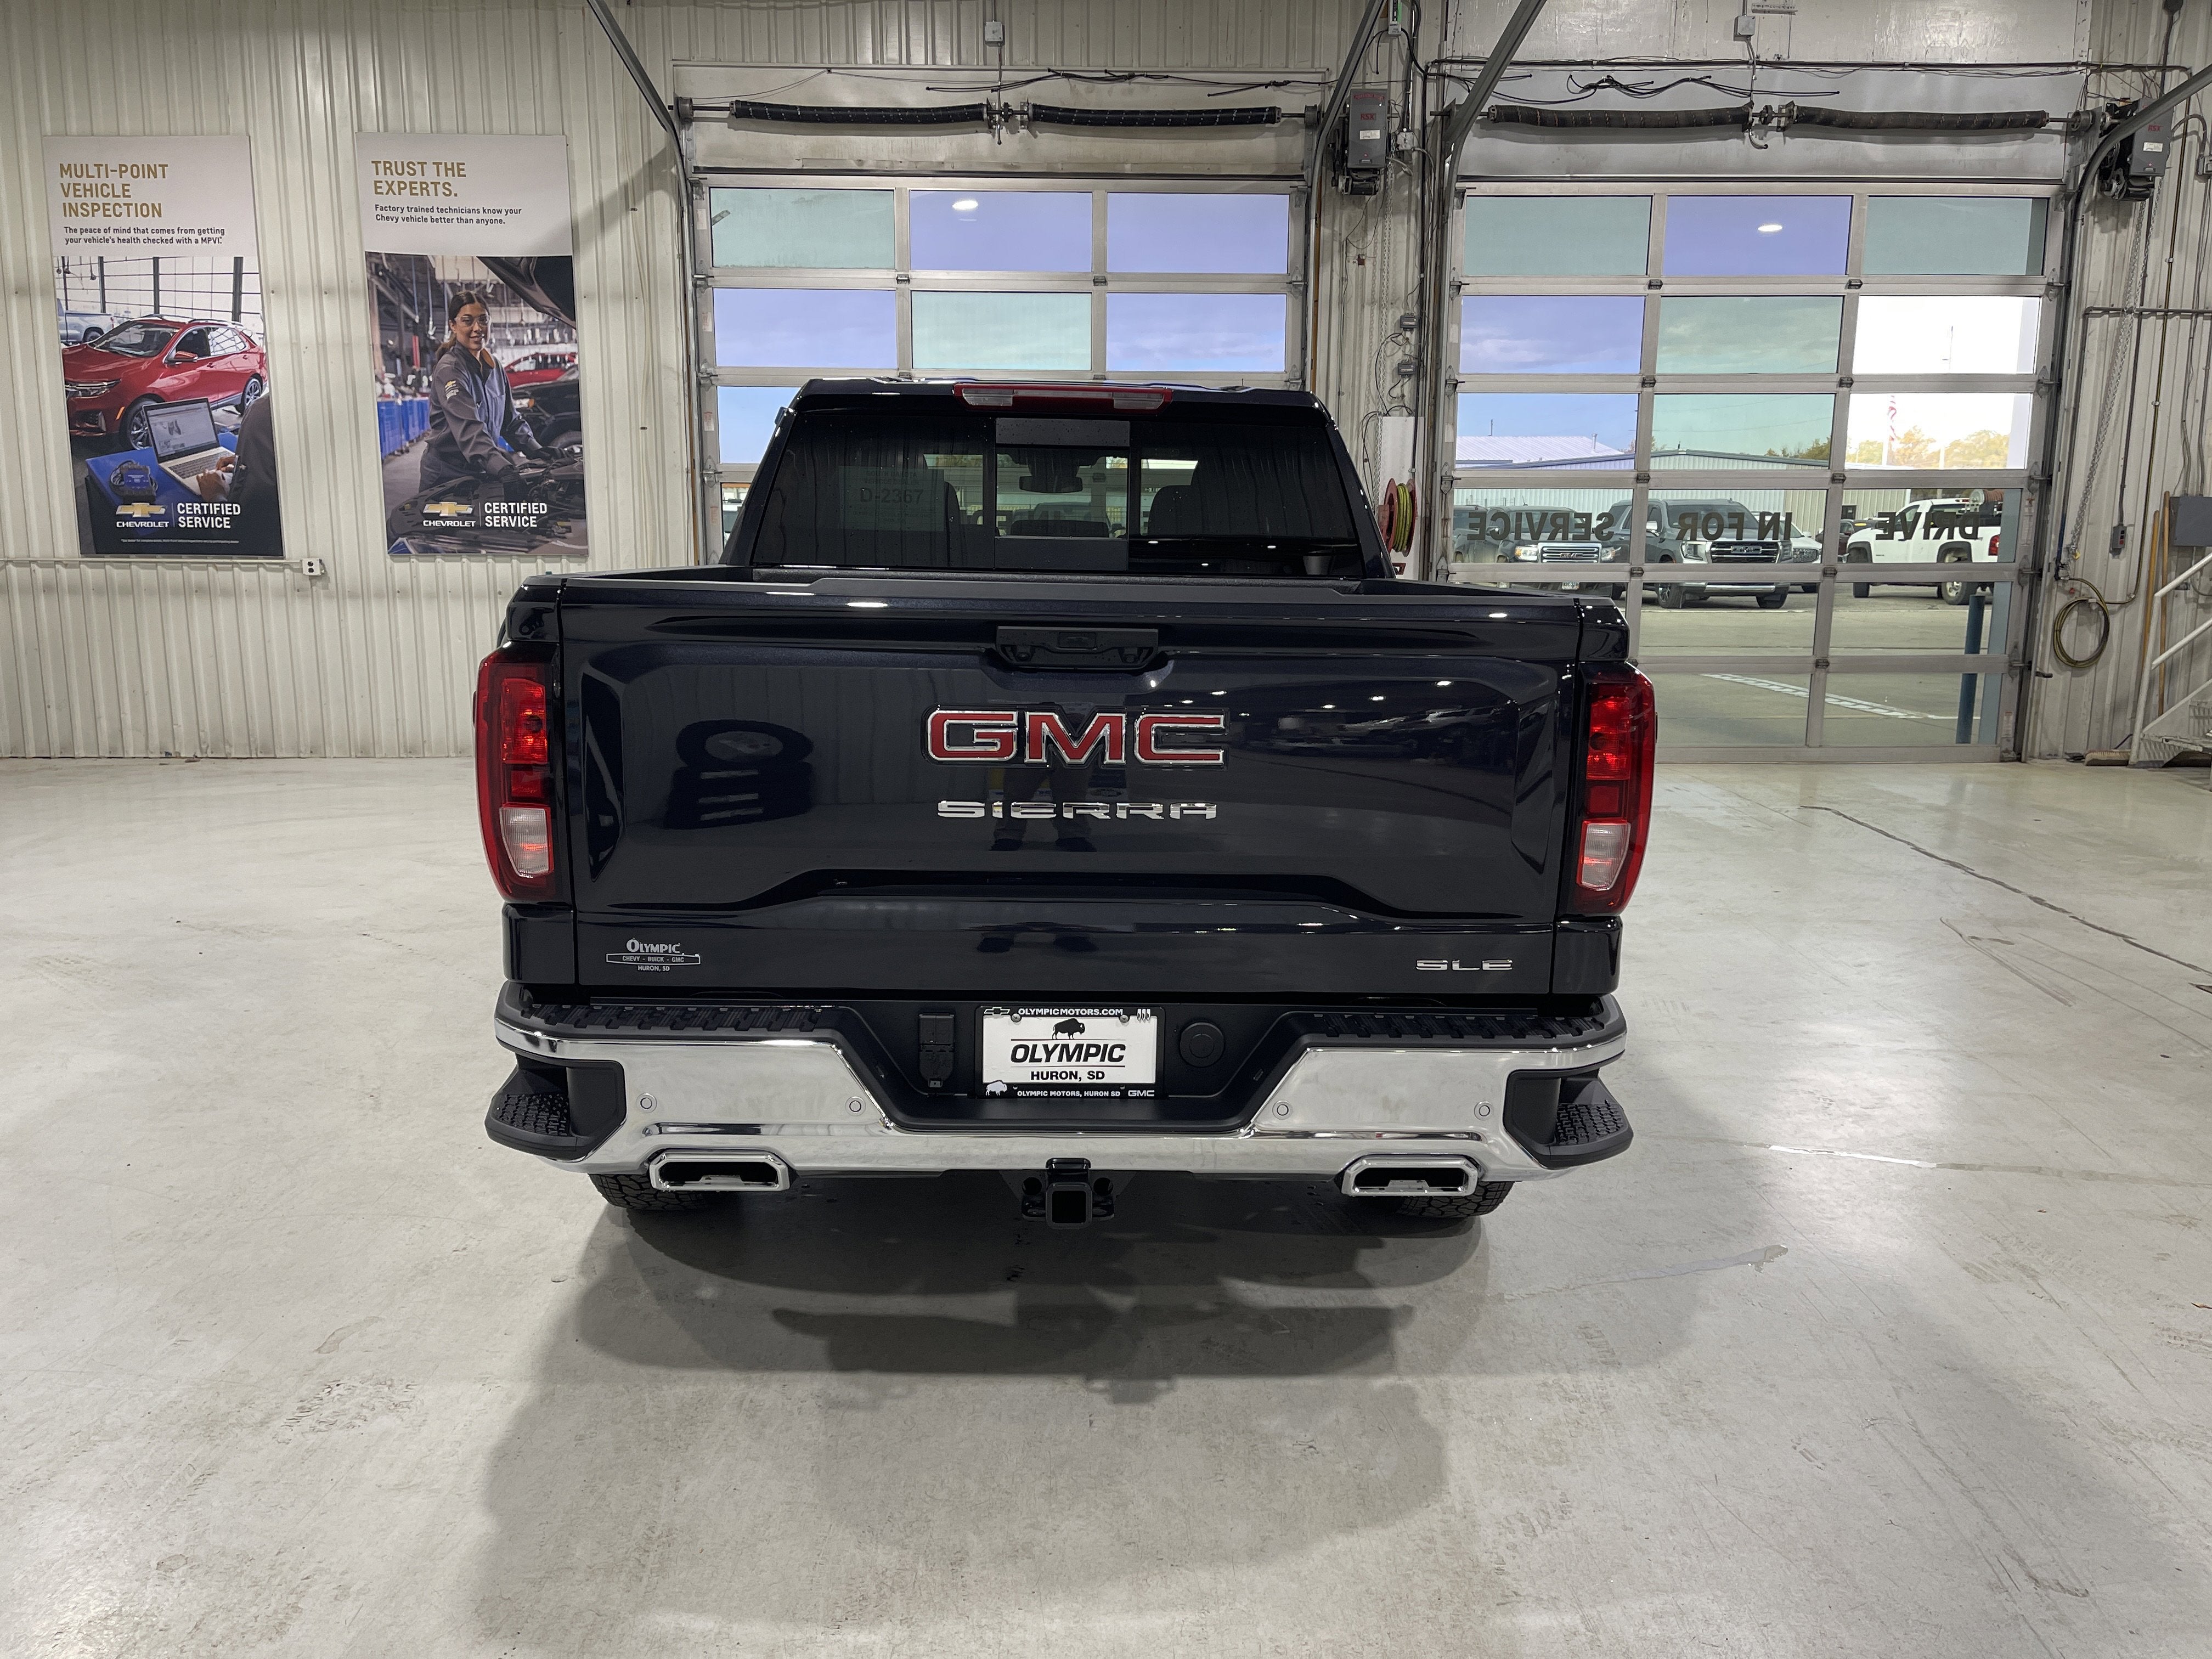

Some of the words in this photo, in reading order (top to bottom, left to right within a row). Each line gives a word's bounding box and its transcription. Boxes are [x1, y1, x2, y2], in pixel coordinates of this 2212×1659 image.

[60, 163, 168, 179] MULTI-POINT
[371, 161, 427, 176] TRUST
[432, 162, 466, 177] THE
[60, 183, 131, 198] VEHICLE
[374, 180, 458, 197] EXPERTS.
[63, 202, 162, 218] INSPECTION
[375, 204, 405, 213] Factory
[437, 206, 480, 214] technicians
[376, 215, 399, 223] Chevy
[198, 227, 225, 236] getting
[860, 487, 924, 504] D-2367
[177, 503, 241, 515] CERTIFIED
[484, 502, 547, 515] CERTIFIED
[178, 516, 231, 529] SERVICE
[485, 516, 537, 527] SERVICE
[927, 710, 1224, 766] GMC
[938, 800, 1217, 820] SIERRA
[1416, 959, 1513, 970] SLE
[1011, 1043, 1126, 1063] OLYMPIC
[1031, 1071, 1082, 1081] HURON,
[1087, 1071, 1105, 1080] SD
